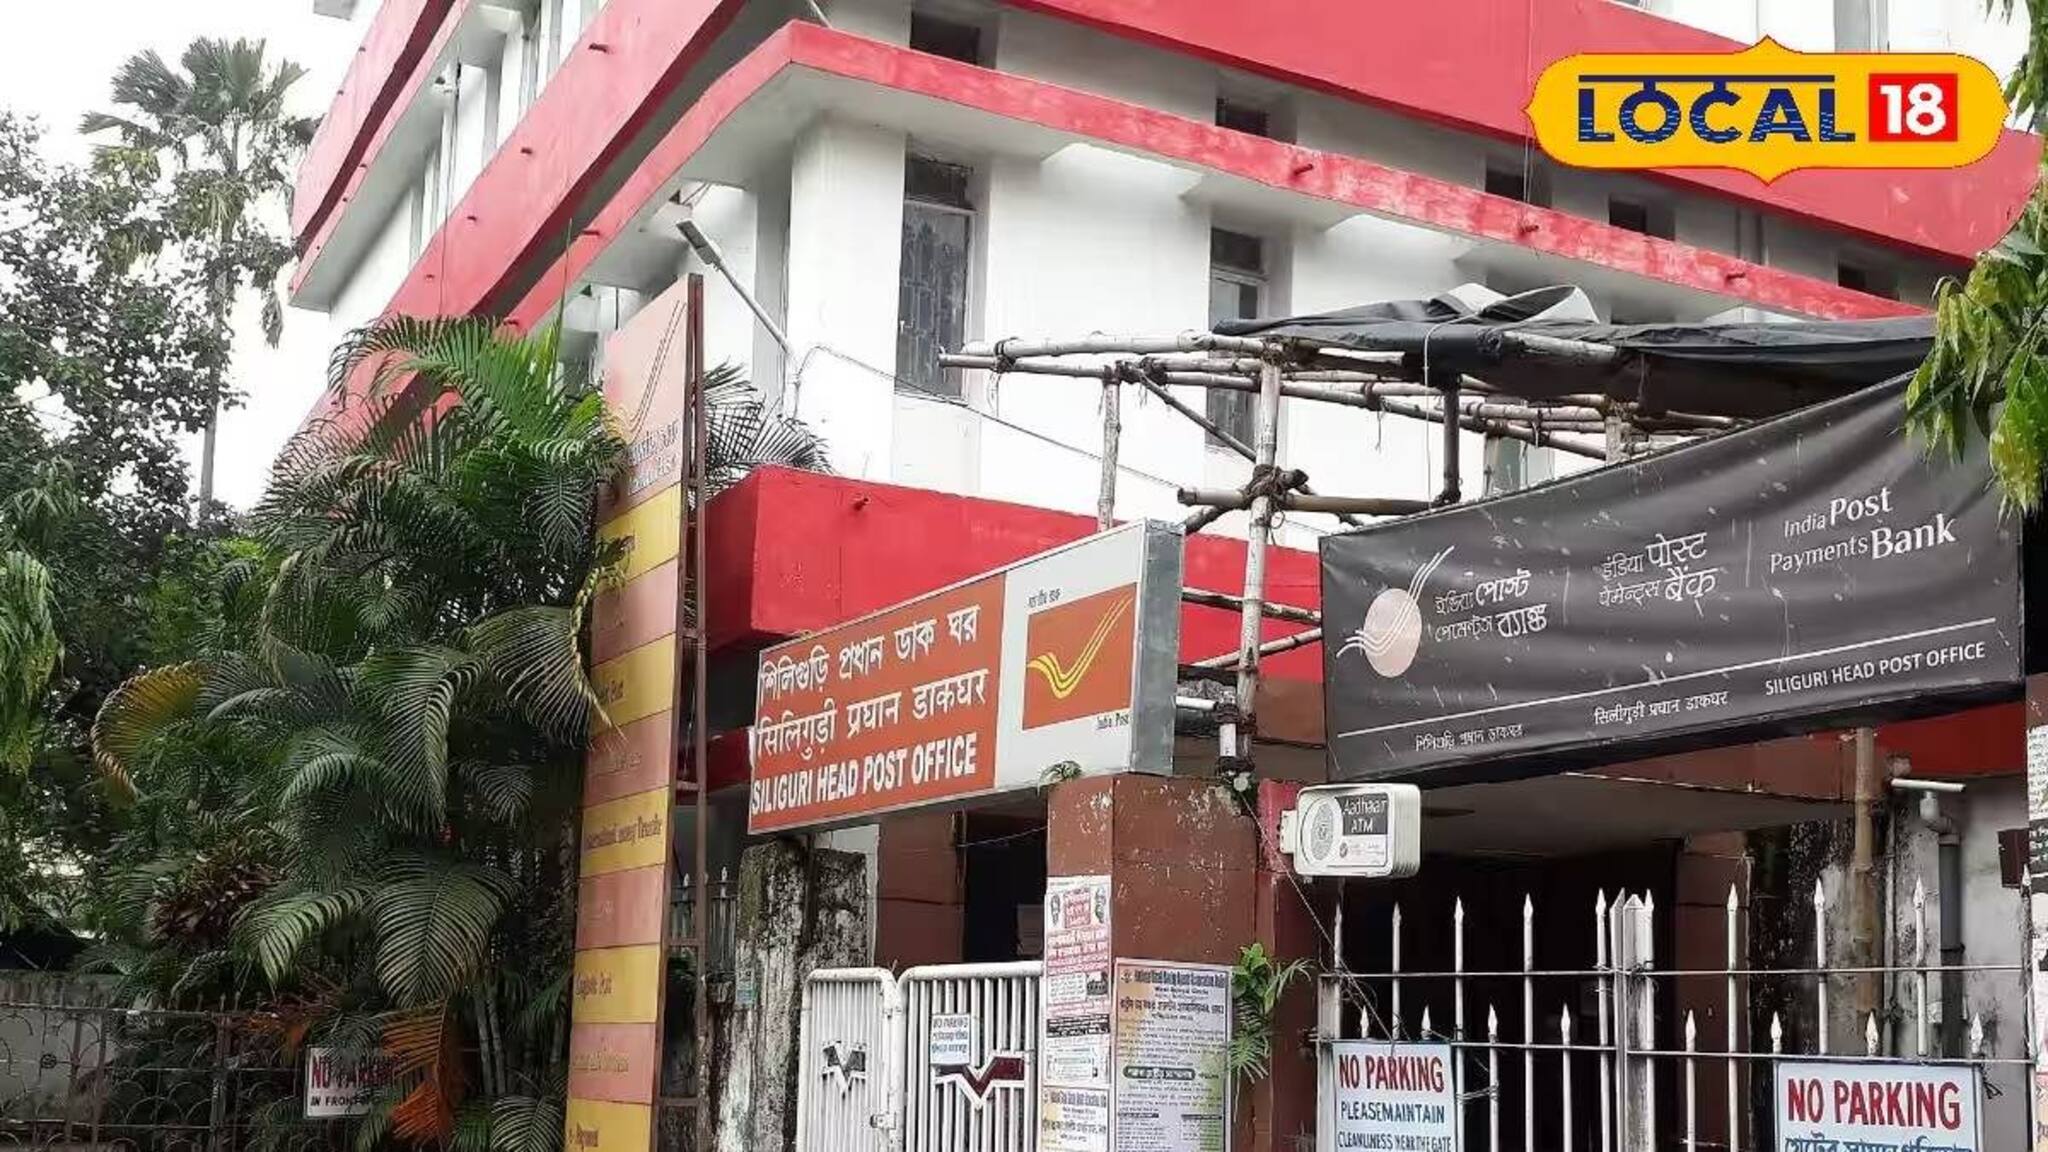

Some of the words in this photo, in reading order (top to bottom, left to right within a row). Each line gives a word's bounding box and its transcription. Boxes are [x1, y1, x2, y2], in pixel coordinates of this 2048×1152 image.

[1784, 513, 1826, 538] India
[1829, 486, 1894, 526] Post
[1601, 553, 1644, 581] इंडिया
[1645, 532, 1708, 568] पोस्ट
[1770, 535, 1868, 574] Payments
[1870, 513, 1957, 560] Bank
[1475, 568, 1532, 606] পোস্ট
[1664, 565, 1719, 602] बैंक
[760, 645, 831, 707] শিলিগুড়ি
[840, 635, 885, 680] প্রধান
[895, 618, 938, 662] ডাক
[946, 604, 981, 645] ঘর
[1765, 671, 1829, 696] SILIGURI
[1832, 662, 1875, 684] HEAD
[1879, 653, 1923, 675] POST
[1926, 642, 1986, 667] OFFICE
[757, 697, 838, 760] सिलिगुड़ी
[846, 692, 902, 738] प्रधान
[912, 668, 989, 720] डाकघर
[1685, 691, 1729, 711] डाकघर
[752, 769, 813, 814] SILIGURI
[816, 758, 859, 802] HEAD
[862, 748, 908, 794] POST
[911, 731, 977, 785] OFFICE
[1342, 796, 1388, 815] Aadhaar
[1351, 818, 1373, 834] ATM
[1339, 1054, 1360, 1090] NO
[1365, 1055, 1445, 1093] PARKING
[1787, 1078, 1825, 1123] NO
[1833, 1079, 1962, 1130] PARKING
[1338, 1131, 1393, 1150] CLEANLINESS
